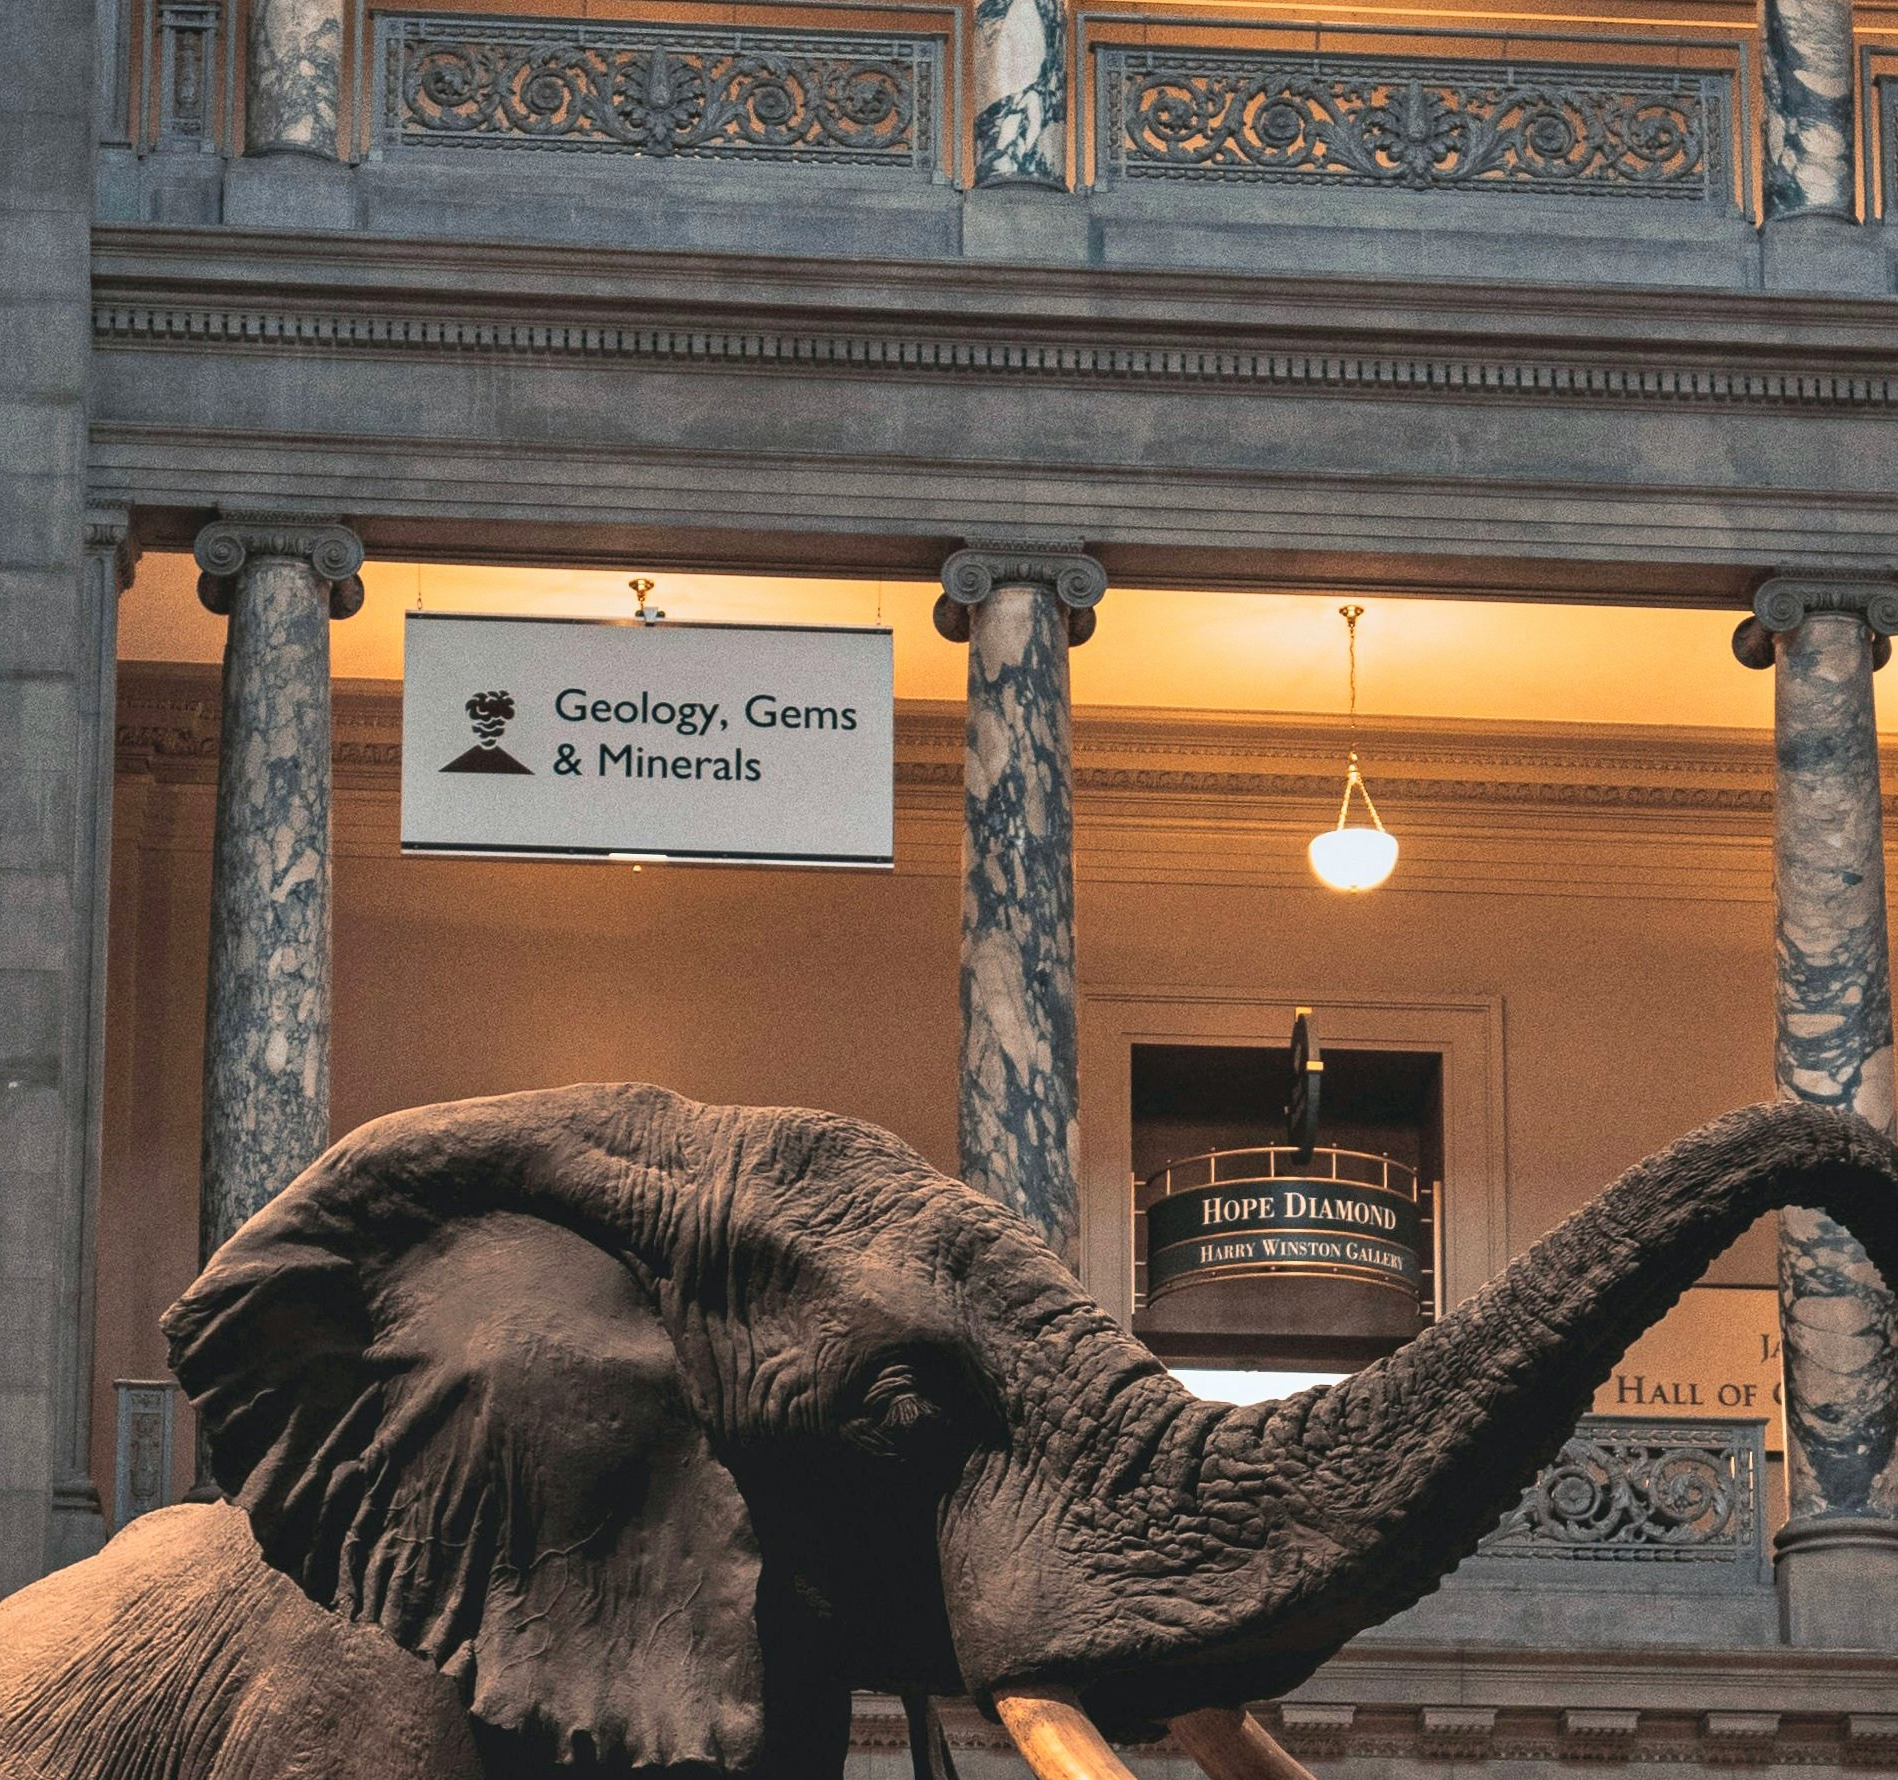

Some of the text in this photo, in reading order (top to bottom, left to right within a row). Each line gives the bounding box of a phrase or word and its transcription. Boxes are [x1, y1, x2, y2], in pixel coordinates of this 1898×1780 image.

[554, 689, 857, 735] Geology, Gems
[553, 744, 761, 781] & Minerals
[1202, 1192, 1396, 1230] HOPE DIAMOND
[1200, 1238, 1404, 1270] HARRY WINSTON GALLERY
[1617, 1375, 1703, 1406] HALL
[1718, 1383, 1757, 1406] OF
